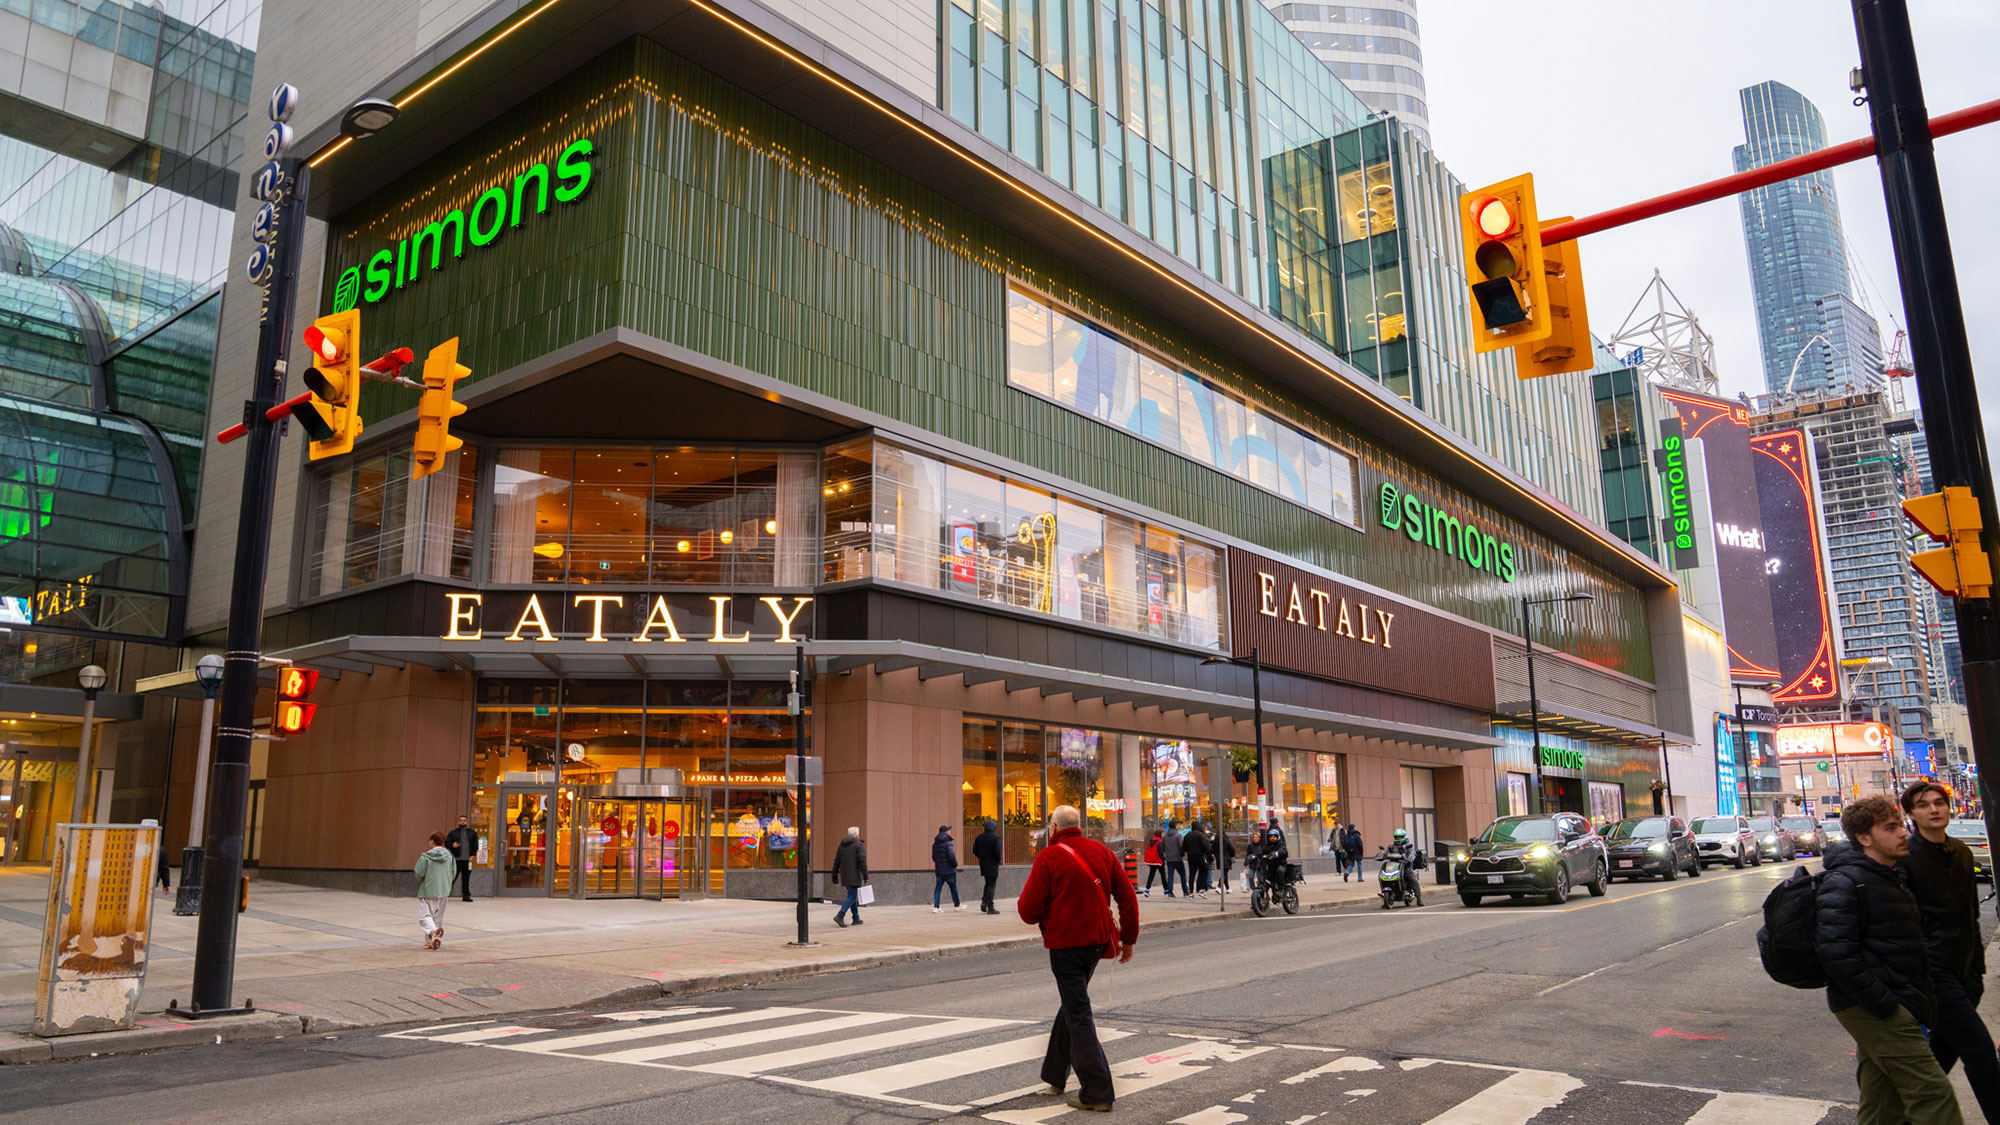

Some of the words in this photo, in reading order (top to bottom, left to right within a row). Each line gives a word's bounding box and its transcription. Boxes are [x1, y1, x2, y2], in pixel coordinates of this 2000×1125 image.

[248, 82, 289, 284] Yonge
[363, 138, 593, 304] simons
[259, 170, 286, 324] DOWNTOWN
[1663, 434, 1692, 534] simons
[1403, 492, 1516, 583] simons
[1715, 521, 1761, 550] What
[24, 574, 93, 621] ATALY
[443, 594, 813, 643] EATALY
[1258, 570, 1395, 649] EATALY
[1742, 708, 1755, 720] CF
[1543, 746, 1584, 771] simons
